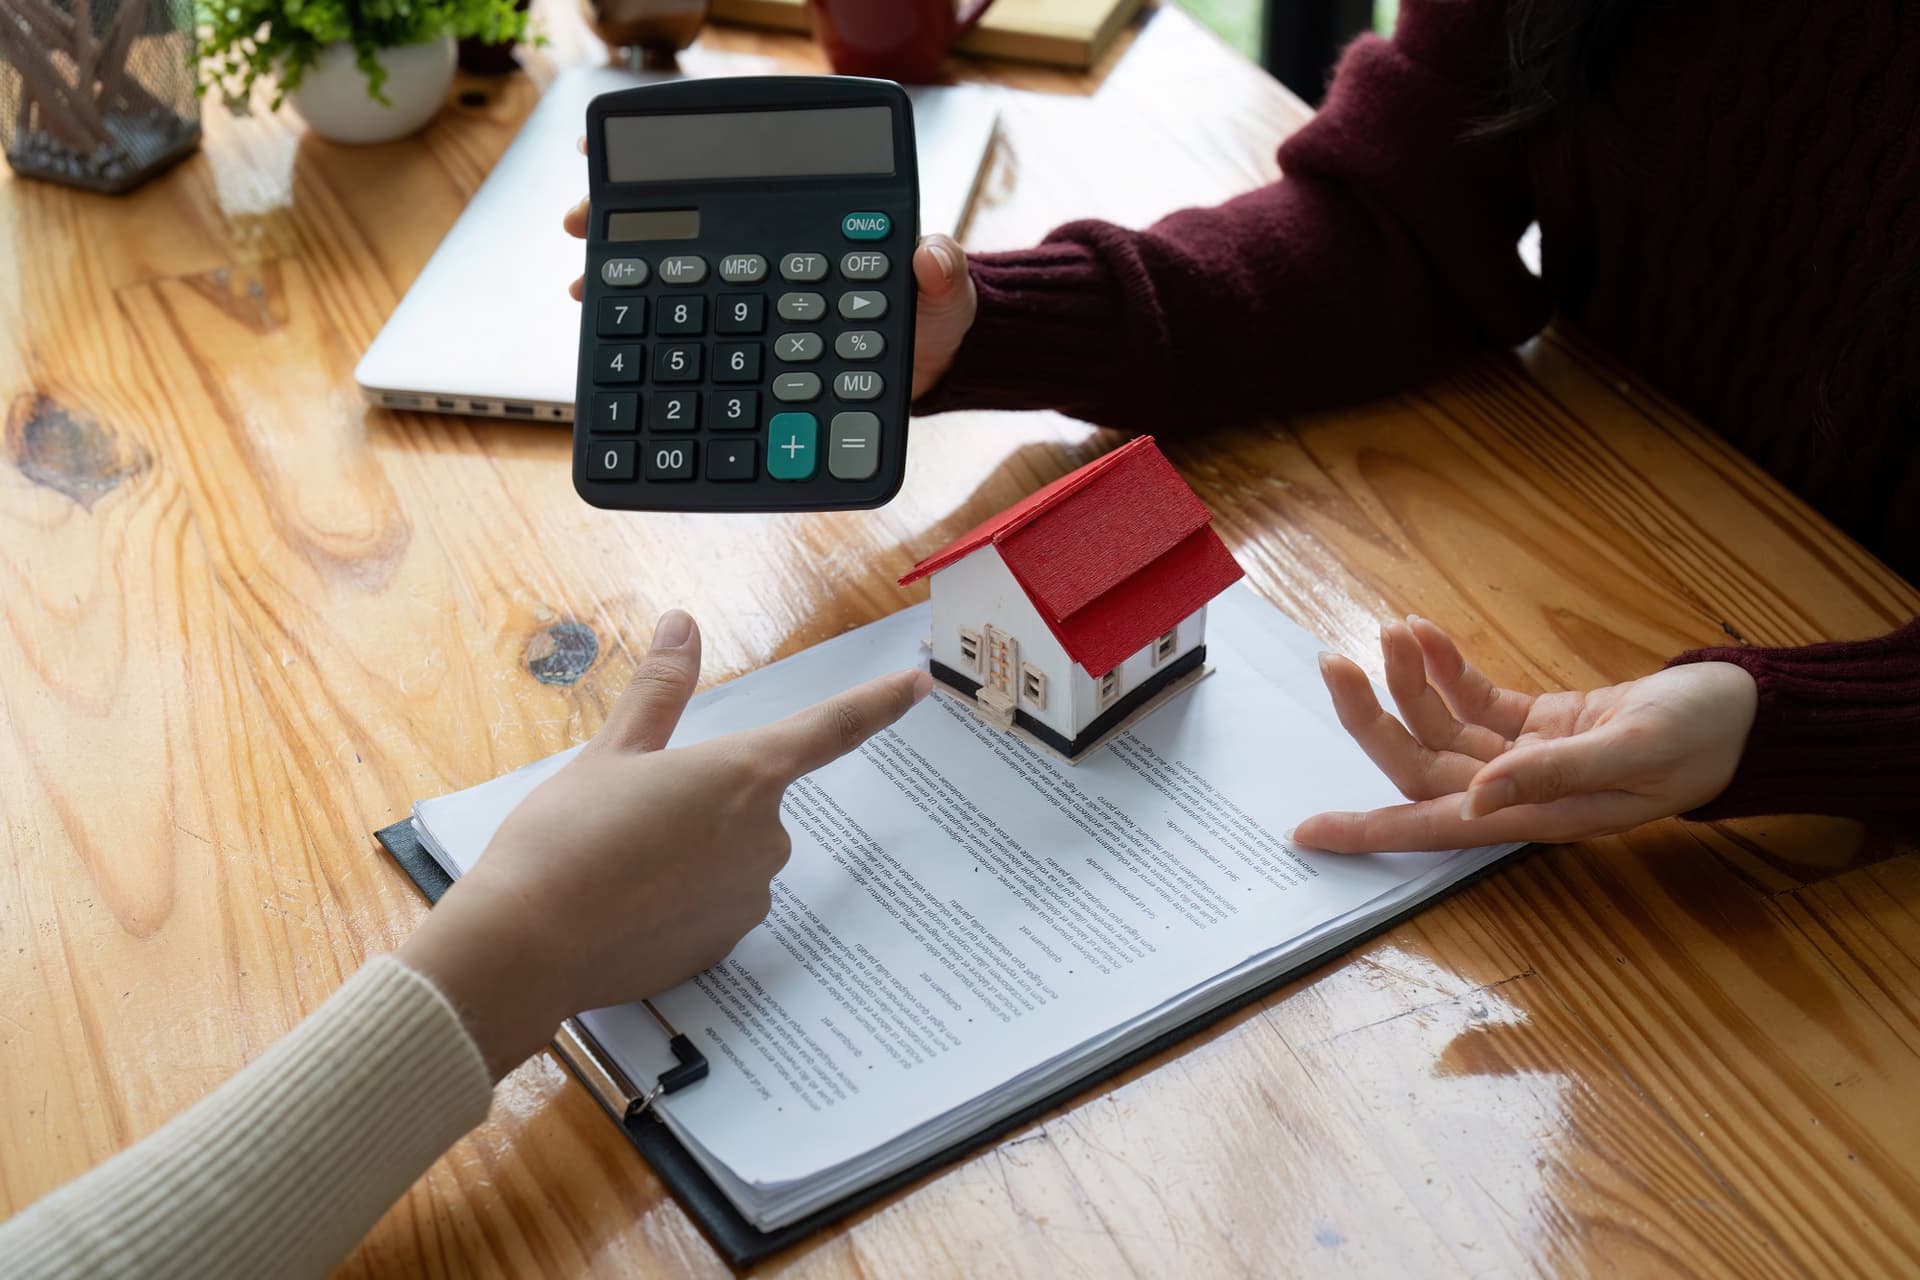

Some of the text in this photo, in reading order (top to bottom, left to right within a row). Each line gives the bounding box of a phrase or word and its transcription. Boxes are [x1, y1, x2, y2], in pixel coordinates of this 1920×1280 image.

[846, 218, 885, 231] ON/AC
[608, 263, 636, 278] M+
[725, 258, 758, 275] MRC
[790, 256, 816, 273] GT
[847, 255, 881, 272] OFF
[615, 305, 629, 325] 7
[674, 304, 688, 324] 8
[734, 302, 748, 322] 9
[851, 335, 867, 351] %
[610, 353, 624, 372] 4
[670, 351, 684, 370] 5
[731, 351, 745, 370] 6
[843, 375, 872, 392] MU
[609, 401, 618, 421] 1
[666, 400, 681, 419] 2
[727, 398, 741, 418] 3
[781, 435, 805, 459] +
[841, 438, 866, 448] =
[604, 450, 618, 470] 0
[656, 449, 683, 469] 00
